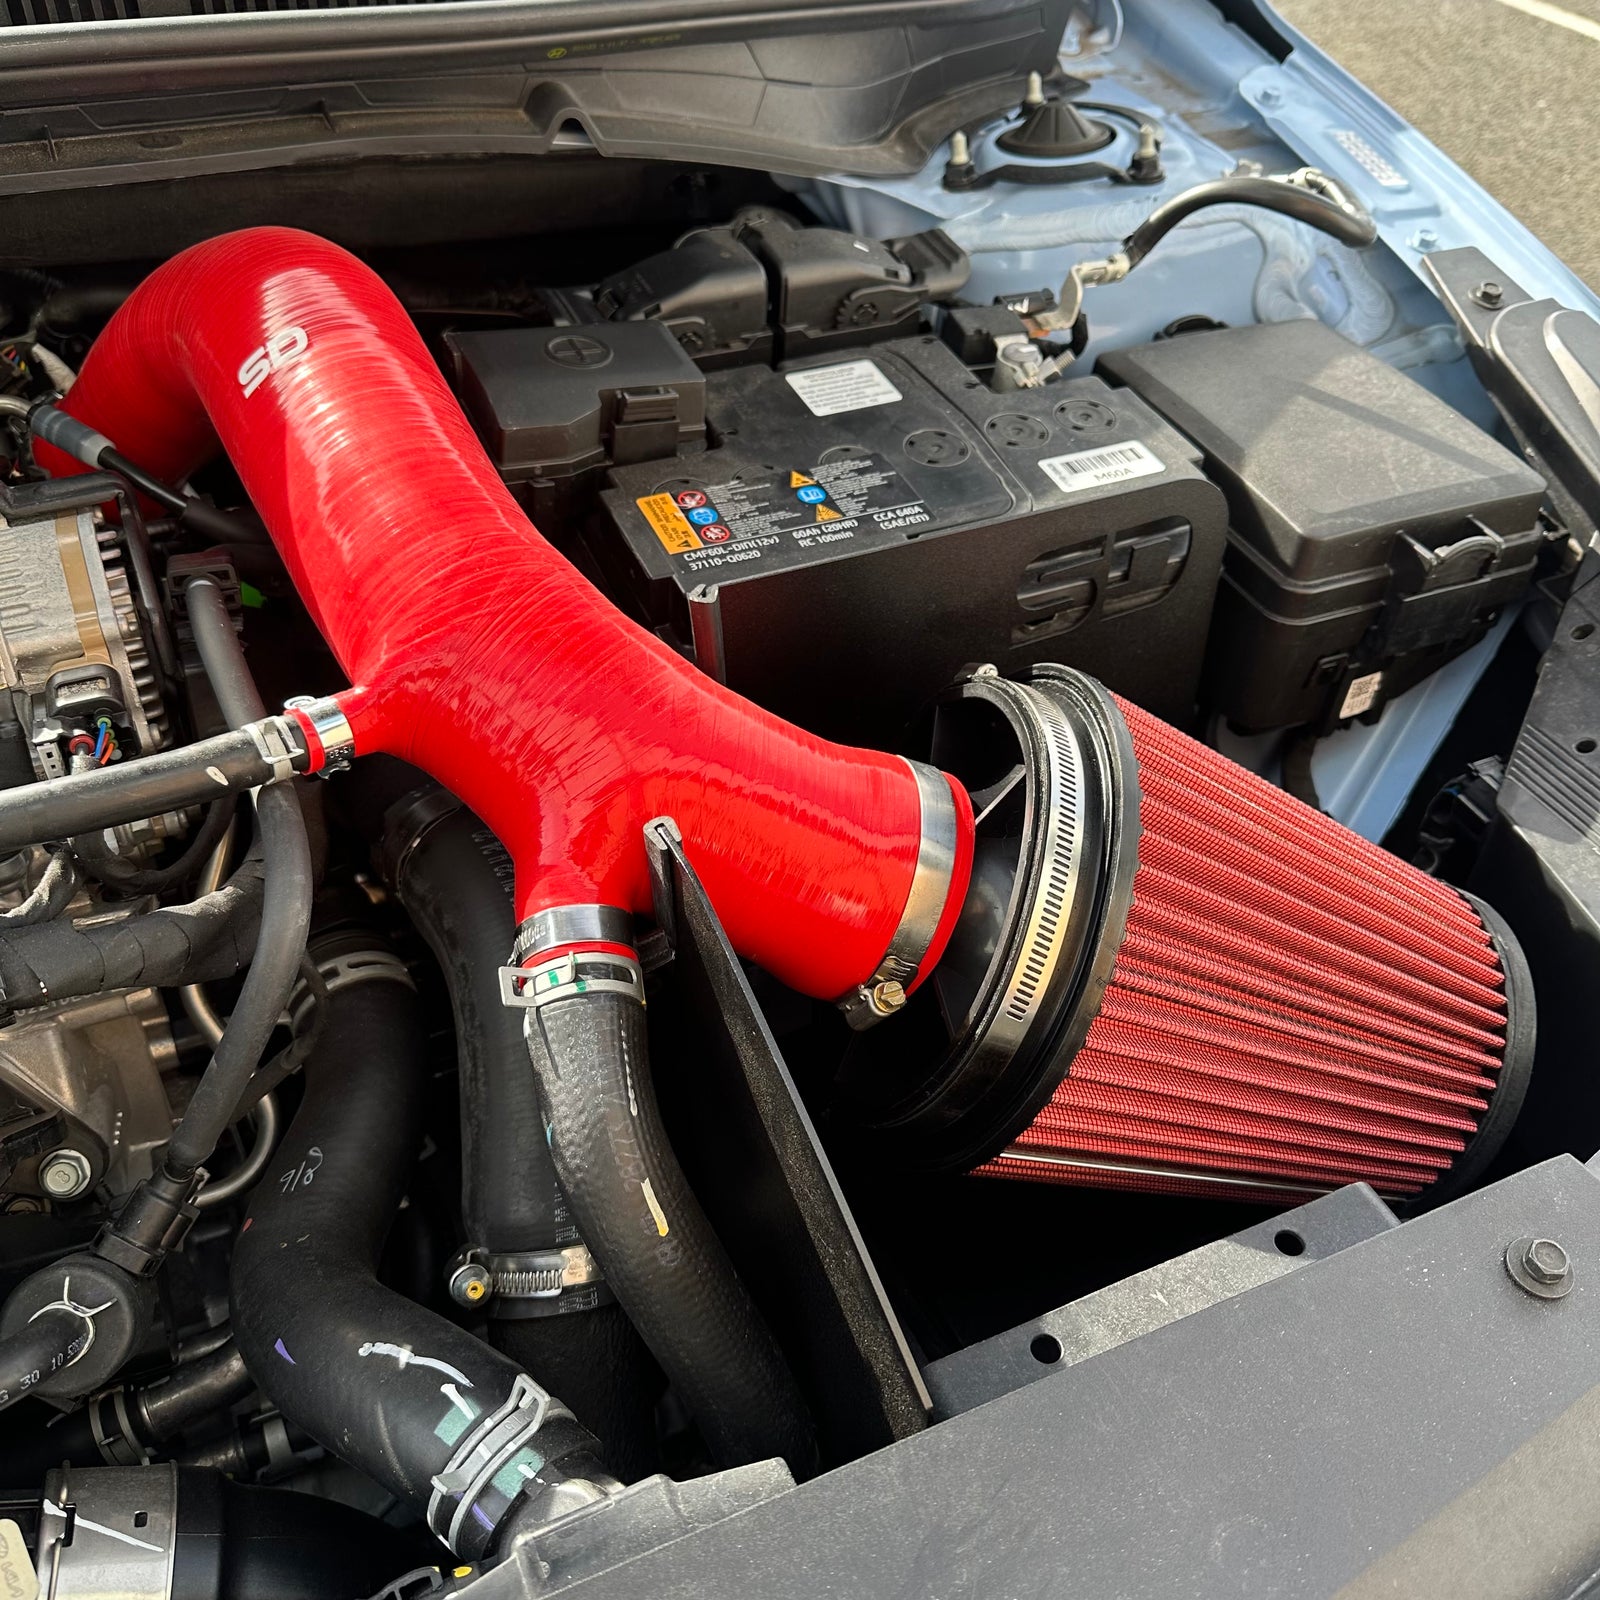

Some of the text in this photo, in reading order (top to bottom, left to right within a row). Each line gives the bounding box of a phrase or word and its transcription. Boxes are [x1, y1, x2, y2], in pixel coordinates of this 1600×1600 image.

[237, 326, 309, 399] SD
[872, 504, 924, 522] CCA 640A
[792, 519, 859, 539] 60Ah (20HR)
[798, 530, 854, 548] RC 100min
[1009, 515, 1193, 650] SD
[20, 1369, 40, 1390] 30
[51, 1353, 64, 1371] 10
